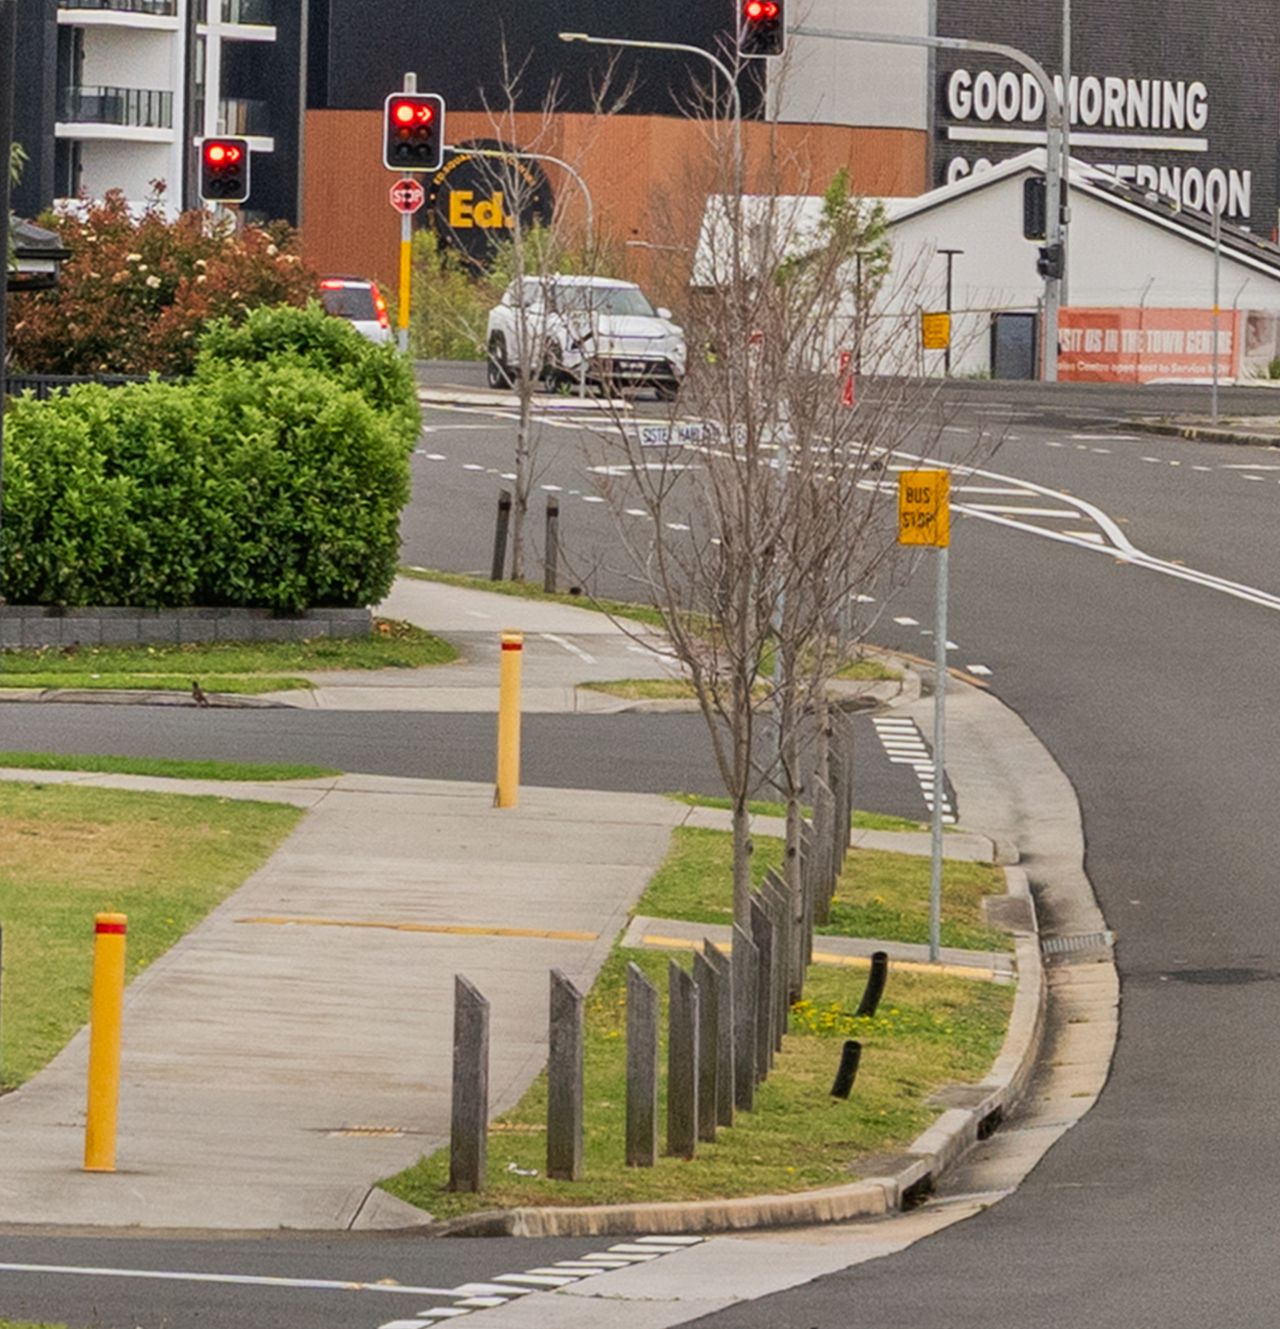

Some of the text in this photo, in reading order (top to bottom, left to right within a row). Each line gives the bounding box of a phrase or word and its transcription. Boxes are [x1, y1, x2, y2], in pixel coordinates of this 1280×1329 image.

[948, 69, 1045, 122] GOOD
[393, 189, 422, 203] STOP
[449, 190, 515, 228] Ed.
[643, 427, 669, 443] SISTE
[906, 487, 930, 504] BUS
[902, 512, 935, 528] STOP
